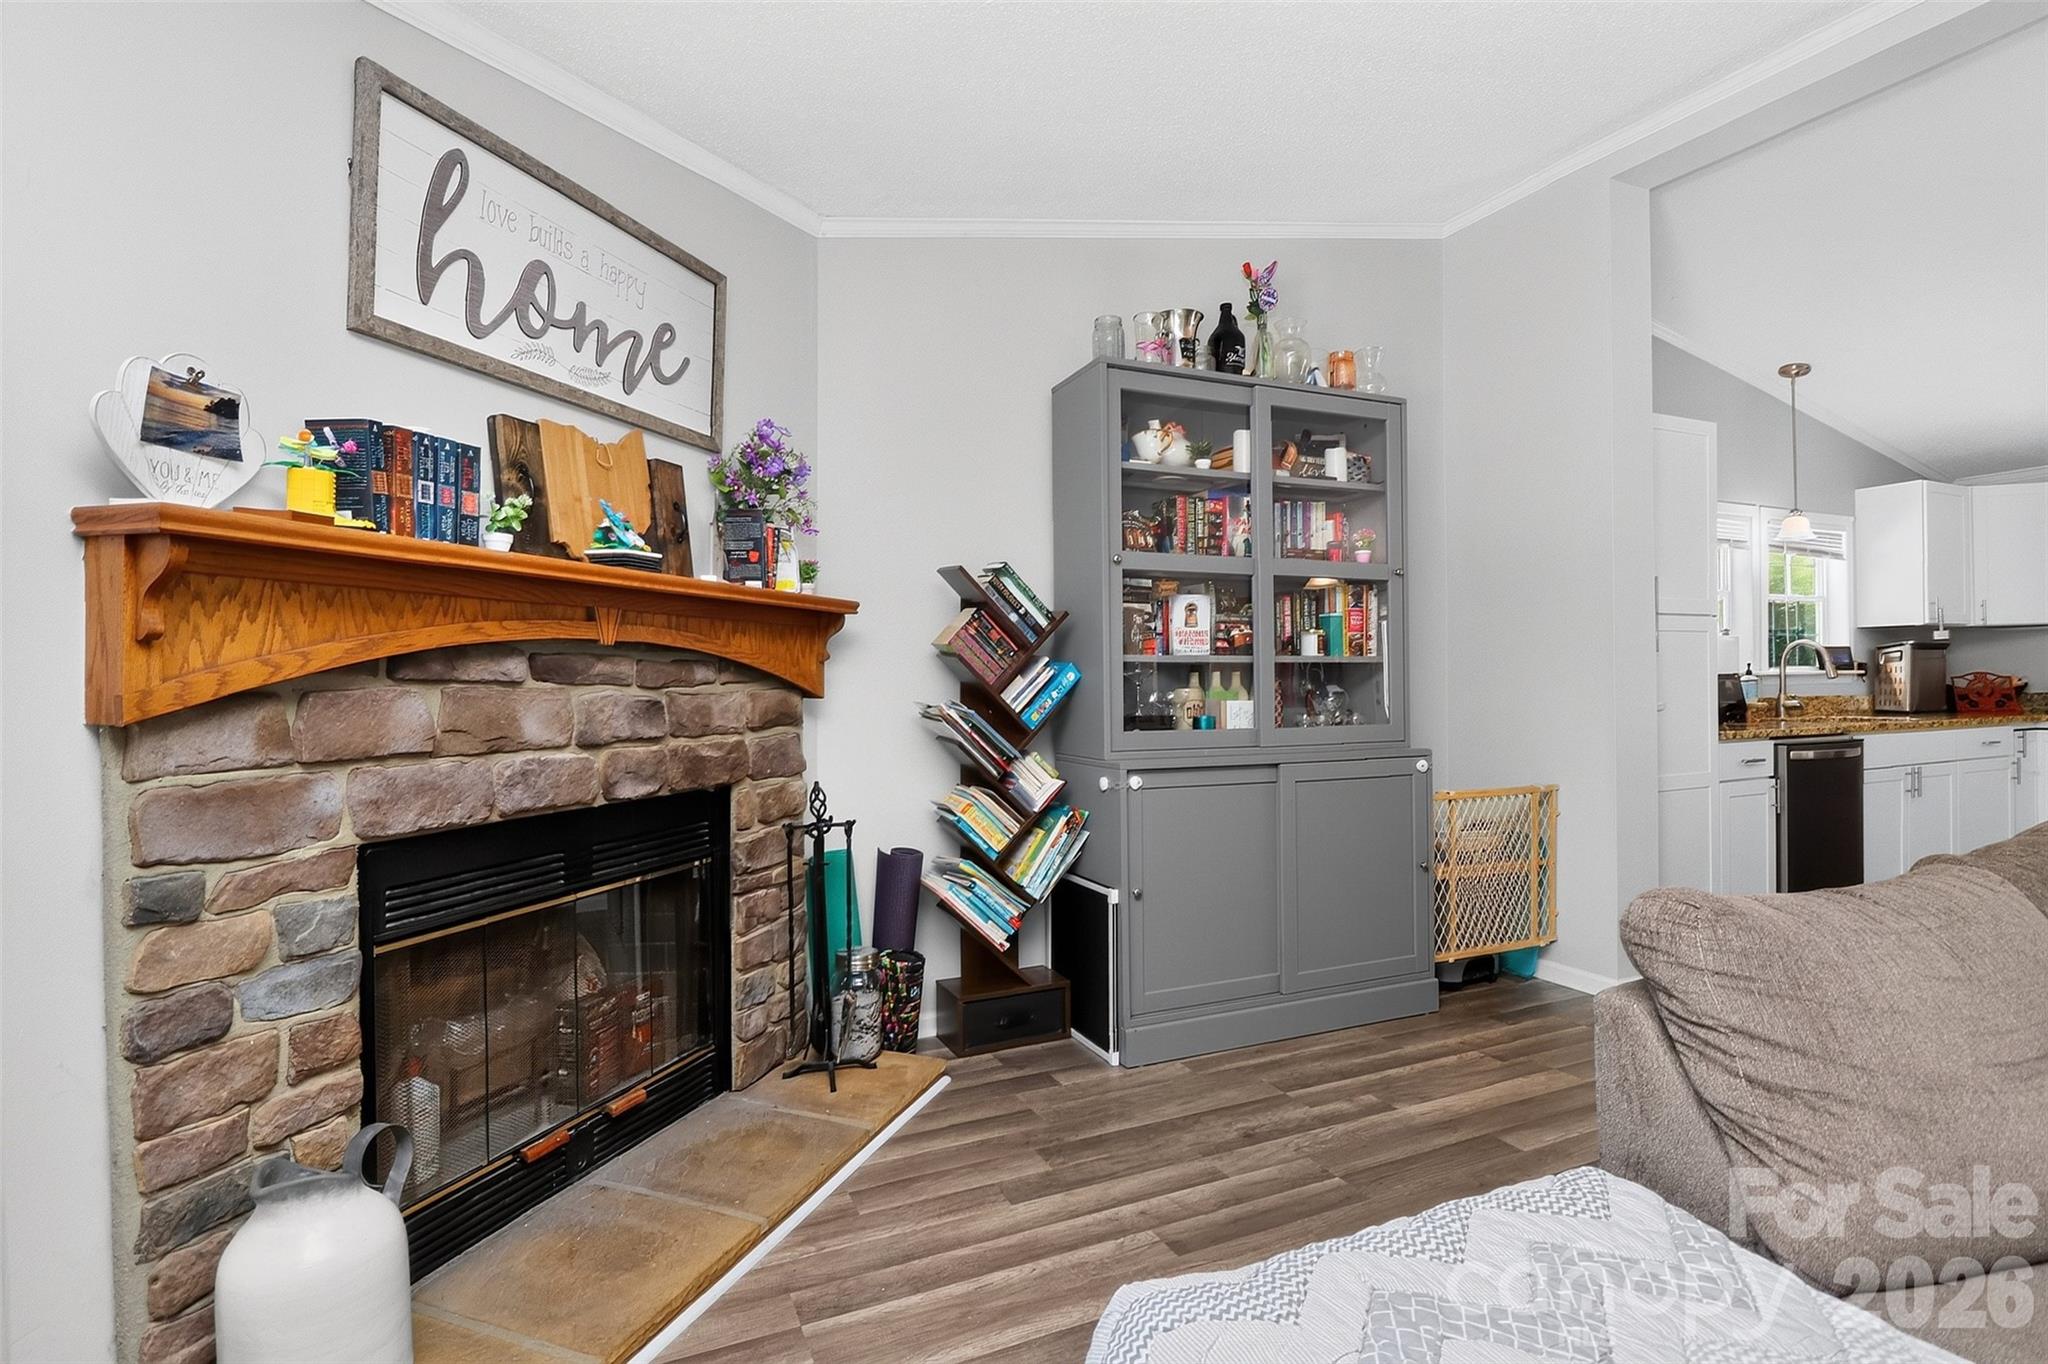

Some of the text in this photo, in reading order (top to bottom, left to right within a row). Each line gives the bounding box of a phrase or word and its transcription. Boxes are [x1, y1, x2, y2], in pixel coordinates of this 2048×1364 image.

[416, 147, 691, 396] home
[479, 188, 648, 311] love builds a happy
[149, 458, 180, 482] YOU
